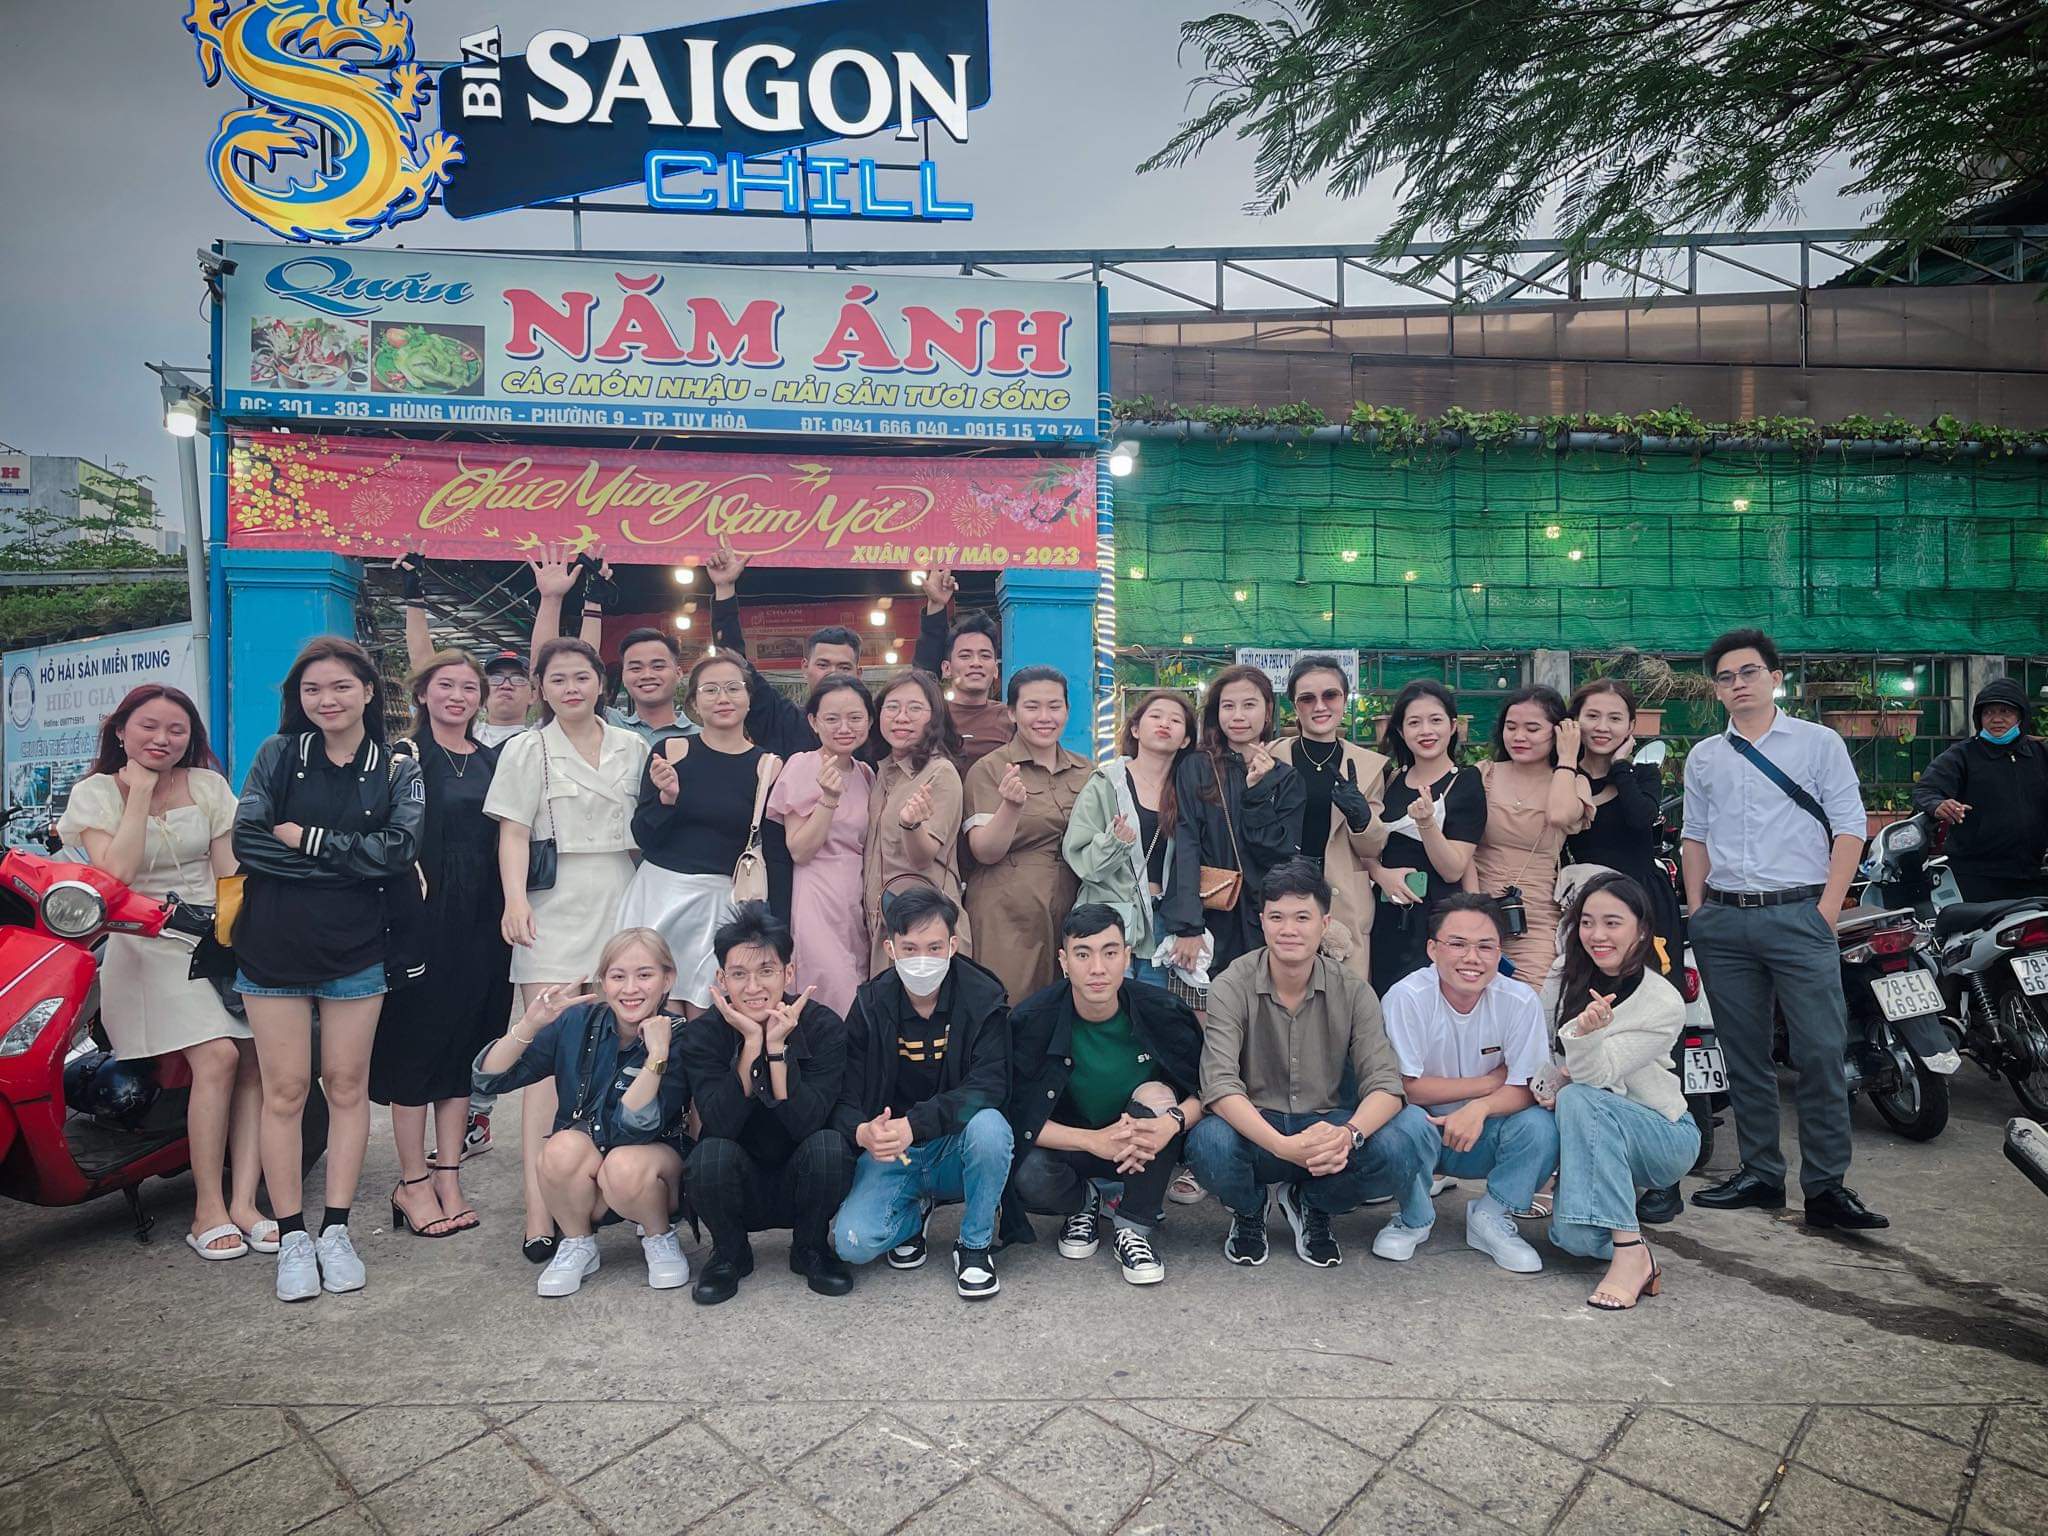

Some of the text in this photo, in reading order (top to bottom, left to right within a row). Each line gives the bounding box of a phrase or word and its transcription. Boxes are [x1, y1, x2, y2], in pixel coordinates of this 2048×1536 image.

[462, 25, 501, 119] BIA
[527, 28, 970, 143] SAIGON
[645, 149, 974, 219] CHILL
[264, 255, 474, 317] Quán
[503, 271, 784, 367] NĂM
[501, 366, 568, 395] CÁC
[568, 368, 652, 397] MÓN
[656, 373, 750, 406] NHẬU
[772, 374, 829, 403] HẢI
[834, 377, 899, 406] SẢN
[904, 383, 976, 409] TƯƠI
[980, 379, 1071, 411] SỐNG
[334, 401, 370, 417] 303
[389, 400, 443, 420] HÙNG
[448, 404, 512, 423] VƯƠNG
[531, 405, 608, 425] PHƯỜNG
[613, 410, 625, 425] 9
[642, 411, 667, 428] TP.
[672, 412, 706, 430] TUY
[711, 411, 749, 430] HÒA
[800, 417, 827, 432] ĐT:
[831, 418, 873, 433] 0941
[879, 419, 911, 434] 666
[916, 421, 948, 435] 040
[965, 422, 1006, 437] 0915
[1011, 424, 1034, 437] 15
[419, 451, 566, 529] Chúc
[850, 543, 910, 564] XUÂN
[1023, 546, 1081, 565] 2023
[40, 659, 55, 684] HỒ
[57, 658, 75, 681] HẢI
[78, 655, 99, 679] SẢN
[102, 648, 128, 675] MIỀN
[131, 649, 171, 671] TRUNG
[2021, 956, 2048, 976] 78-
[1881, 974, 1926, 999] 78-E1
[2024, 975, 2048, 993] 56
[1887, 991, 1940, 1017] 469.59
[1687, 1051, 1713, 1070] -E1
[1686, 1070, 1724, 1090] 6.79
